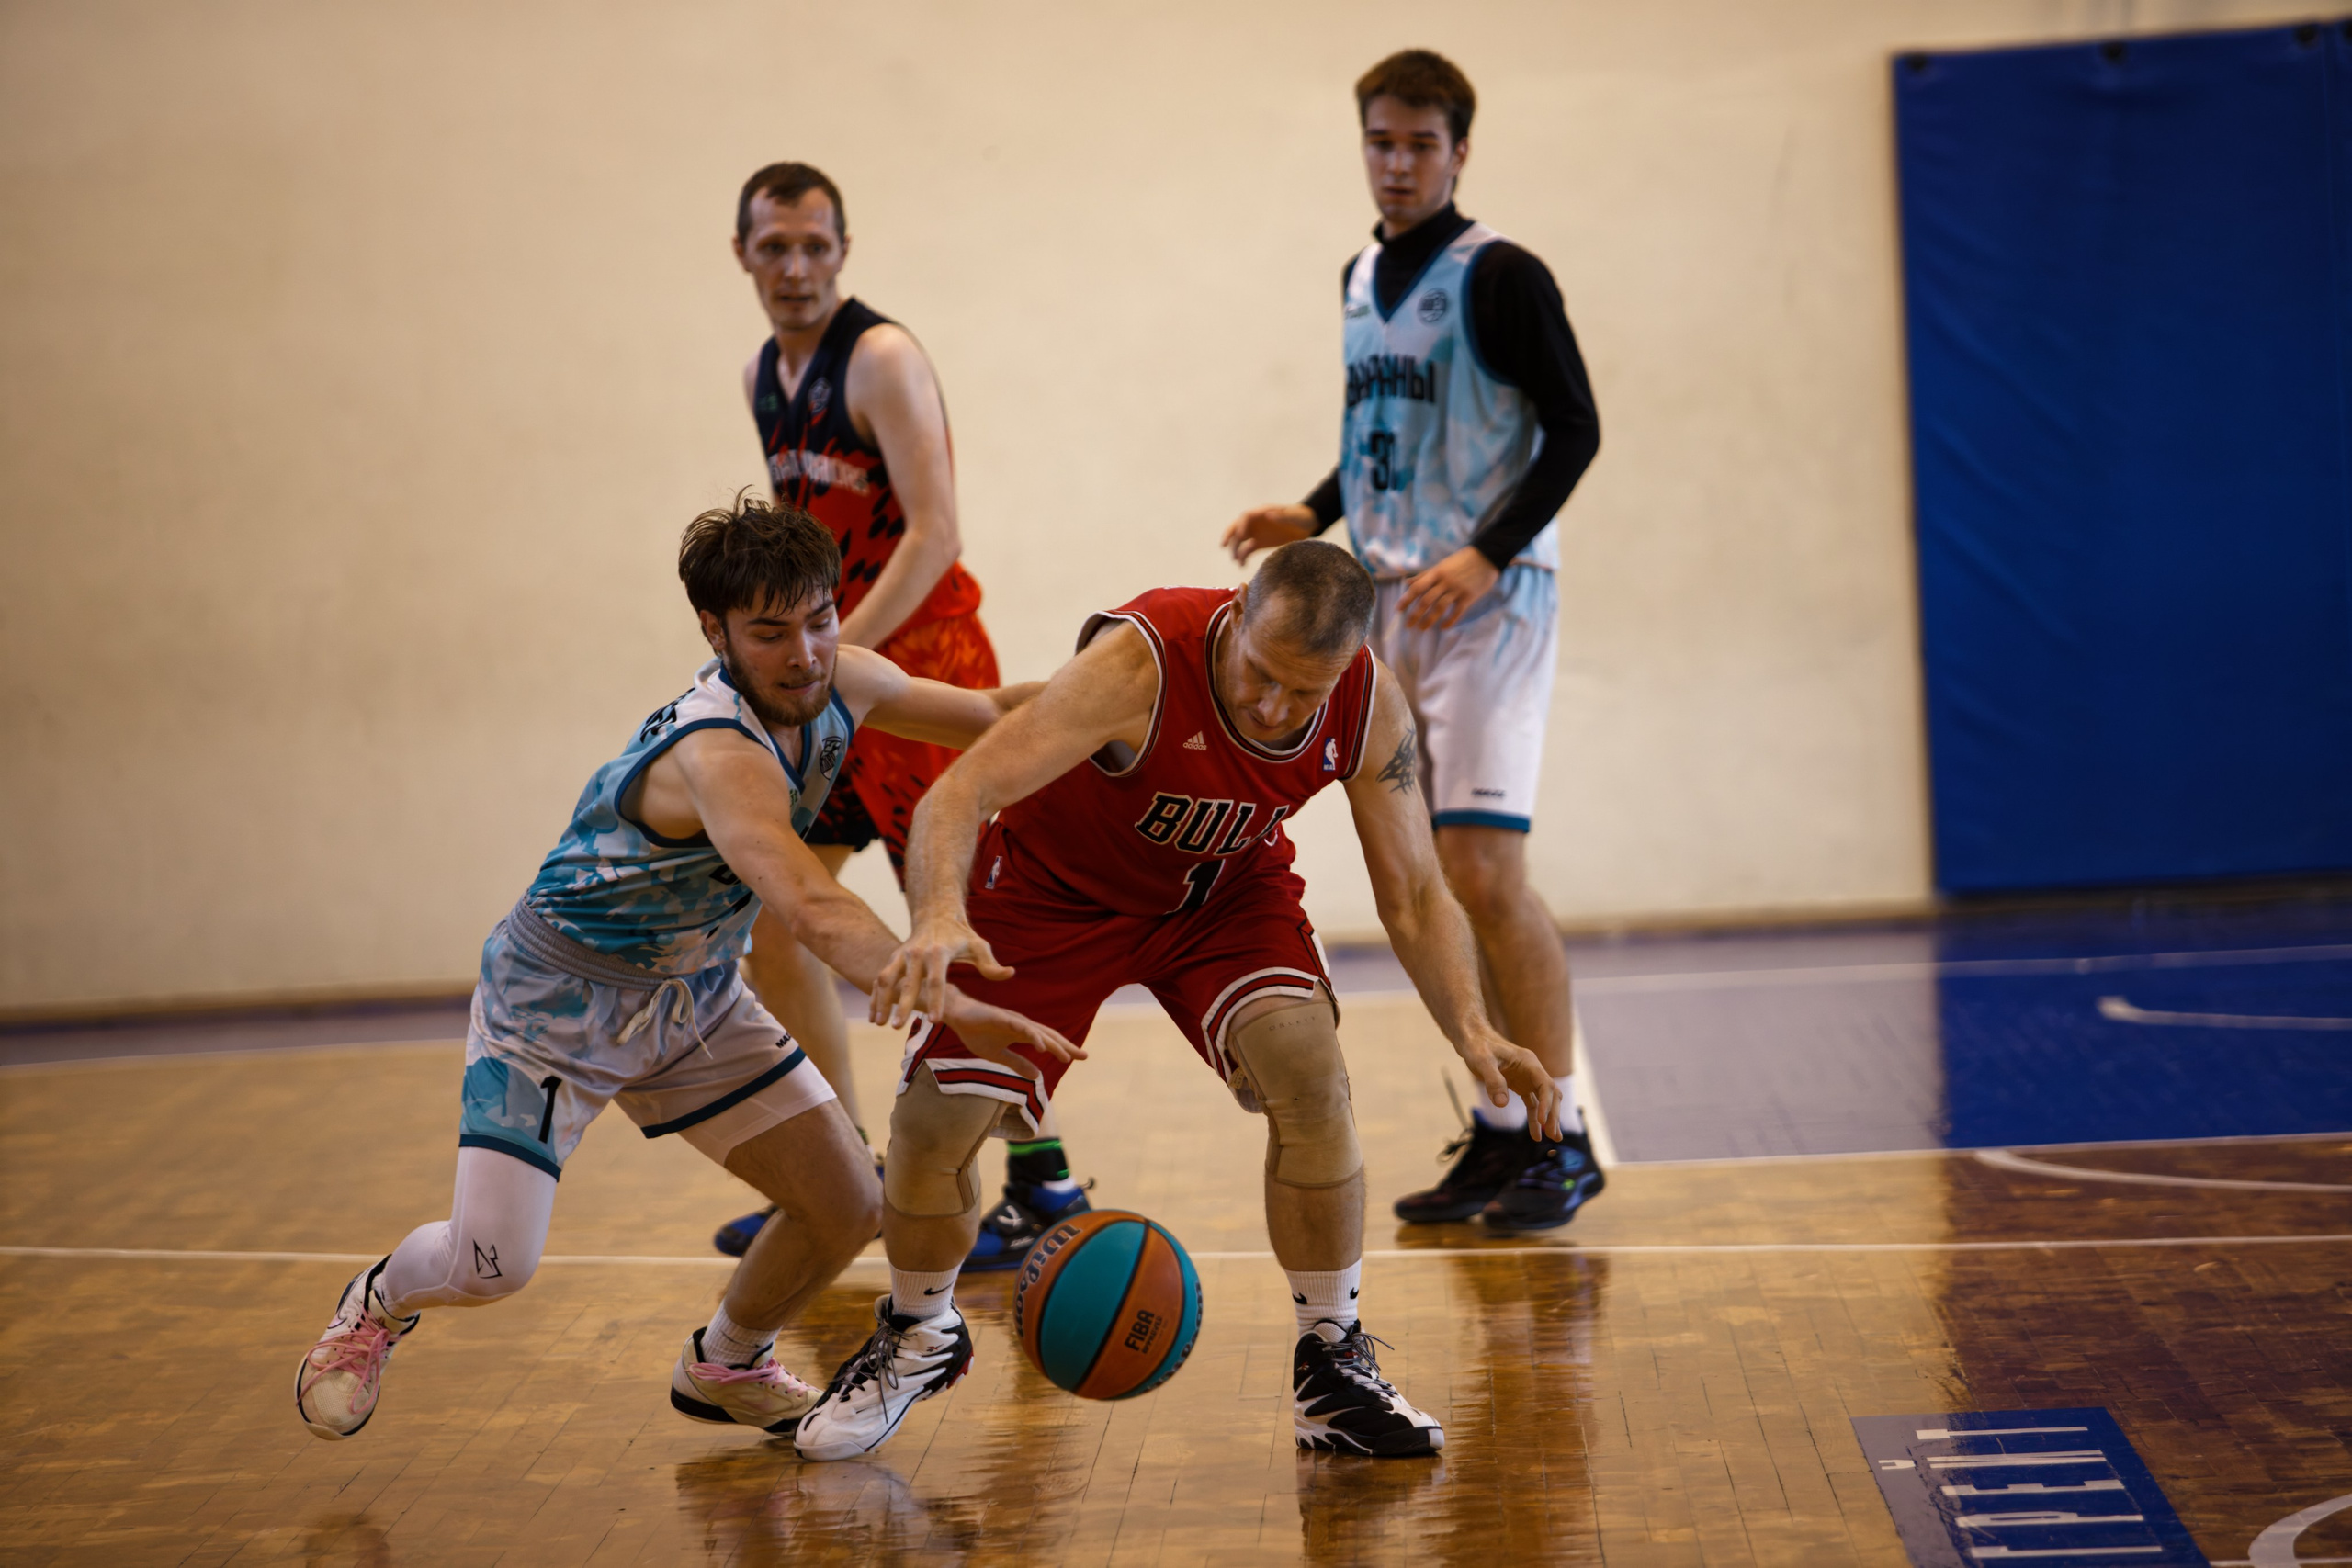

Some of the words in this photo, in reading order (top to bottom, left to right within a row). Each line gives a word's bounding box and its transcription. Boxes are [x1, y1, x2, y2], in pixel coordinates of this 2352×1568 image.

[1182, 741, 1207, 751] adidas
[1162, 858, 1227, 917] 1
[537, 1075, 562, 1145] 1
[1015, 1224, 1082, 1338] Wilson
[1124, 1309, 1155, 1351] FIBA
